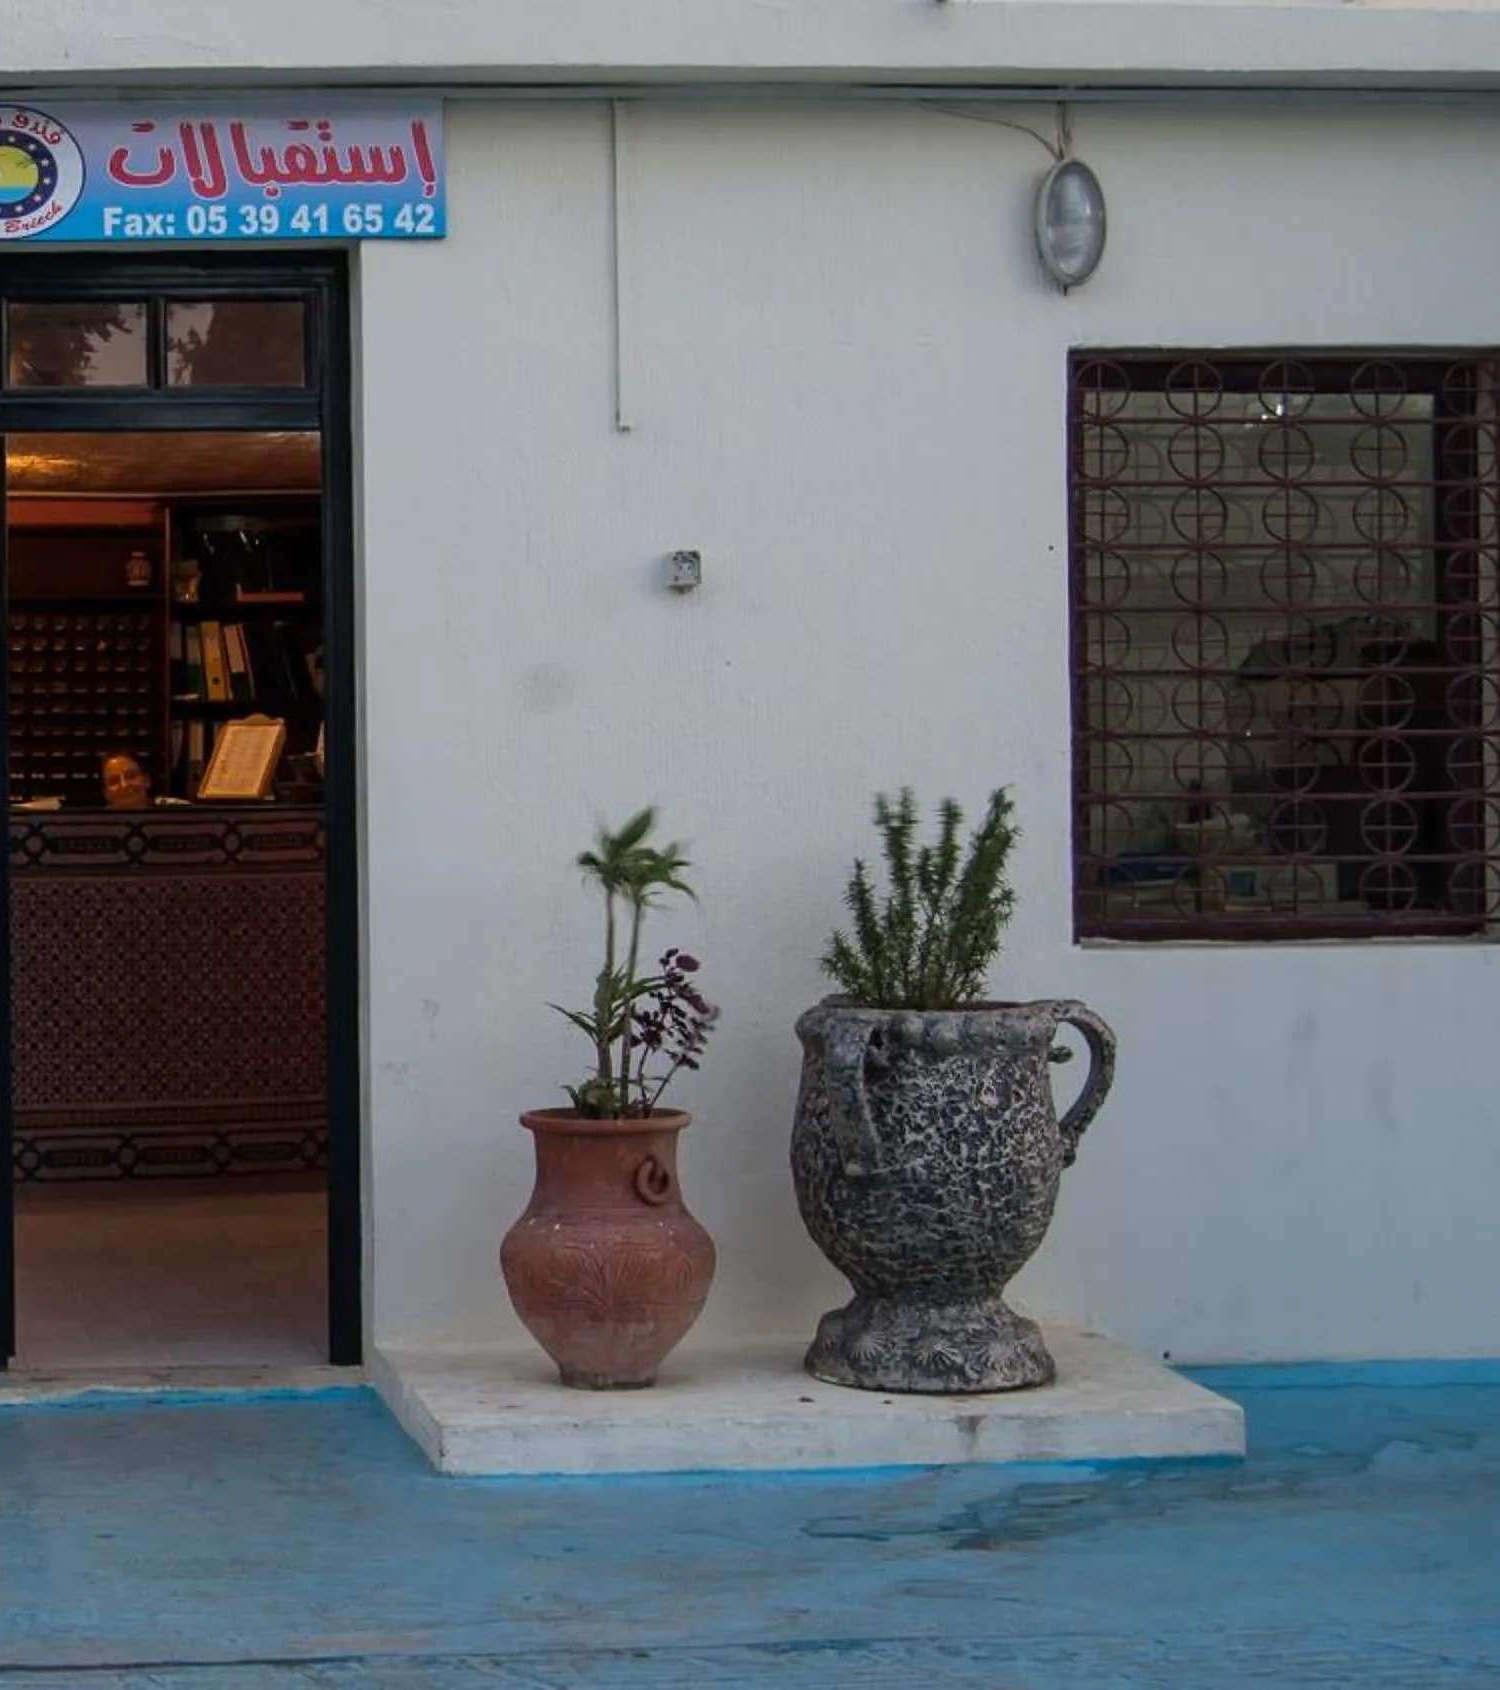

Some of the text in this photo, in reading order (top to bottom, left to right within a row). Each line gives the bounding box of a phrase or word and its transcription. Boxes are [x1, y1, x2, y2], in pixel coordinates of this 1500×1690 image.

[108, 119, 436, 199] إستقبالات
[104, 204, 435, 236] Fax: 05 39 41 65 42
